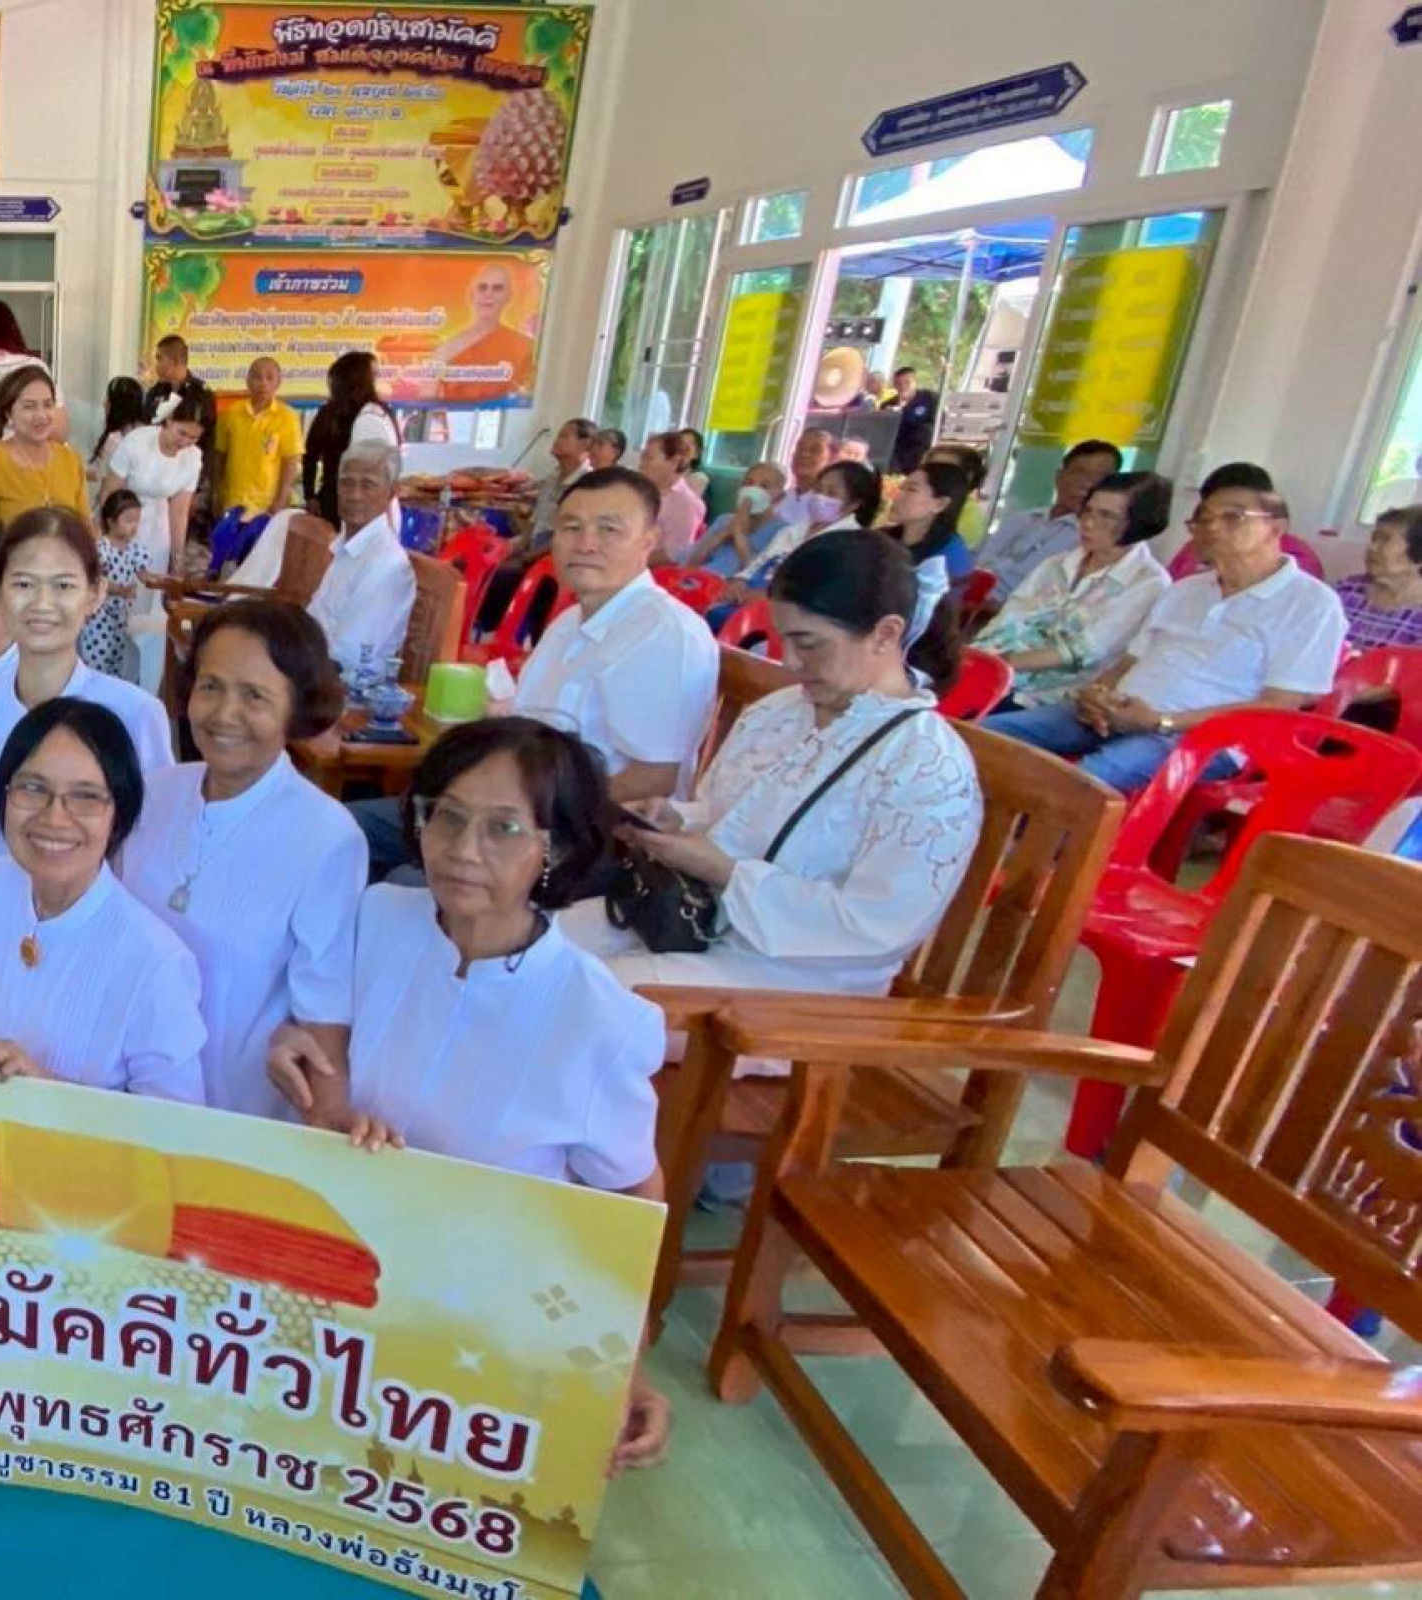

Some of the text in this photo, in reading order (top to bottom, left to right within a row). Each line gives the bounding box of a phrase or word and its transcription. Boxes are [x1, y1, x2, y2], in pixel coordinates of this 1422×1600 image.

[154, 1480, 192, 1508] 81
[206, 1487, 231, 1518] ปี
[245, 1506, 530, 1600] หลวงพ่อธัมมชโ
[342, 1468, 519, 1555] 2568
